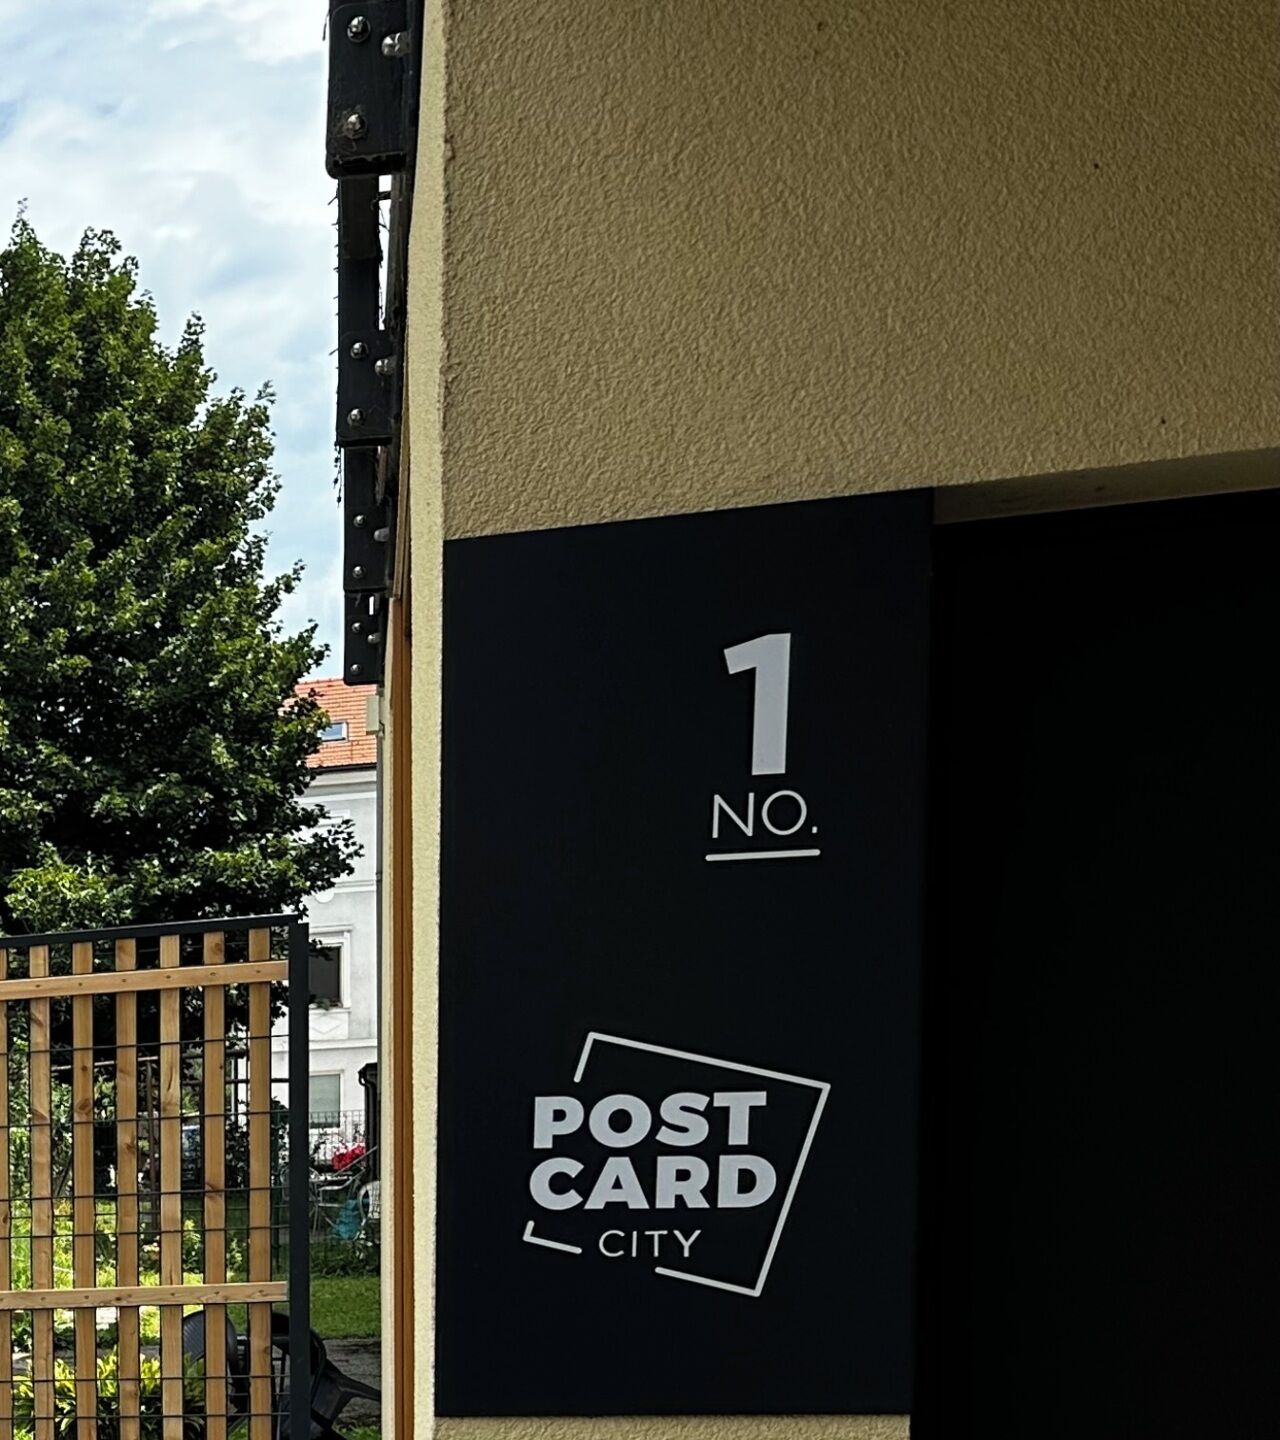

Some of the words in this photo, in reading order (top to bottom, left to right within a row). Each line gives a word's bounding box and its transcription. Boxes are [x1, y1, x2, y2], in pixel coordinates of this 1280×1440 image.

[723, 632, 791, 776] 1
[712, 790, 818, 839] NO.
[533, 1091, 767, 1149] POST
[529, 1154, 777, 1211] CARD
[598, 1229, 702, 1258] CITY
